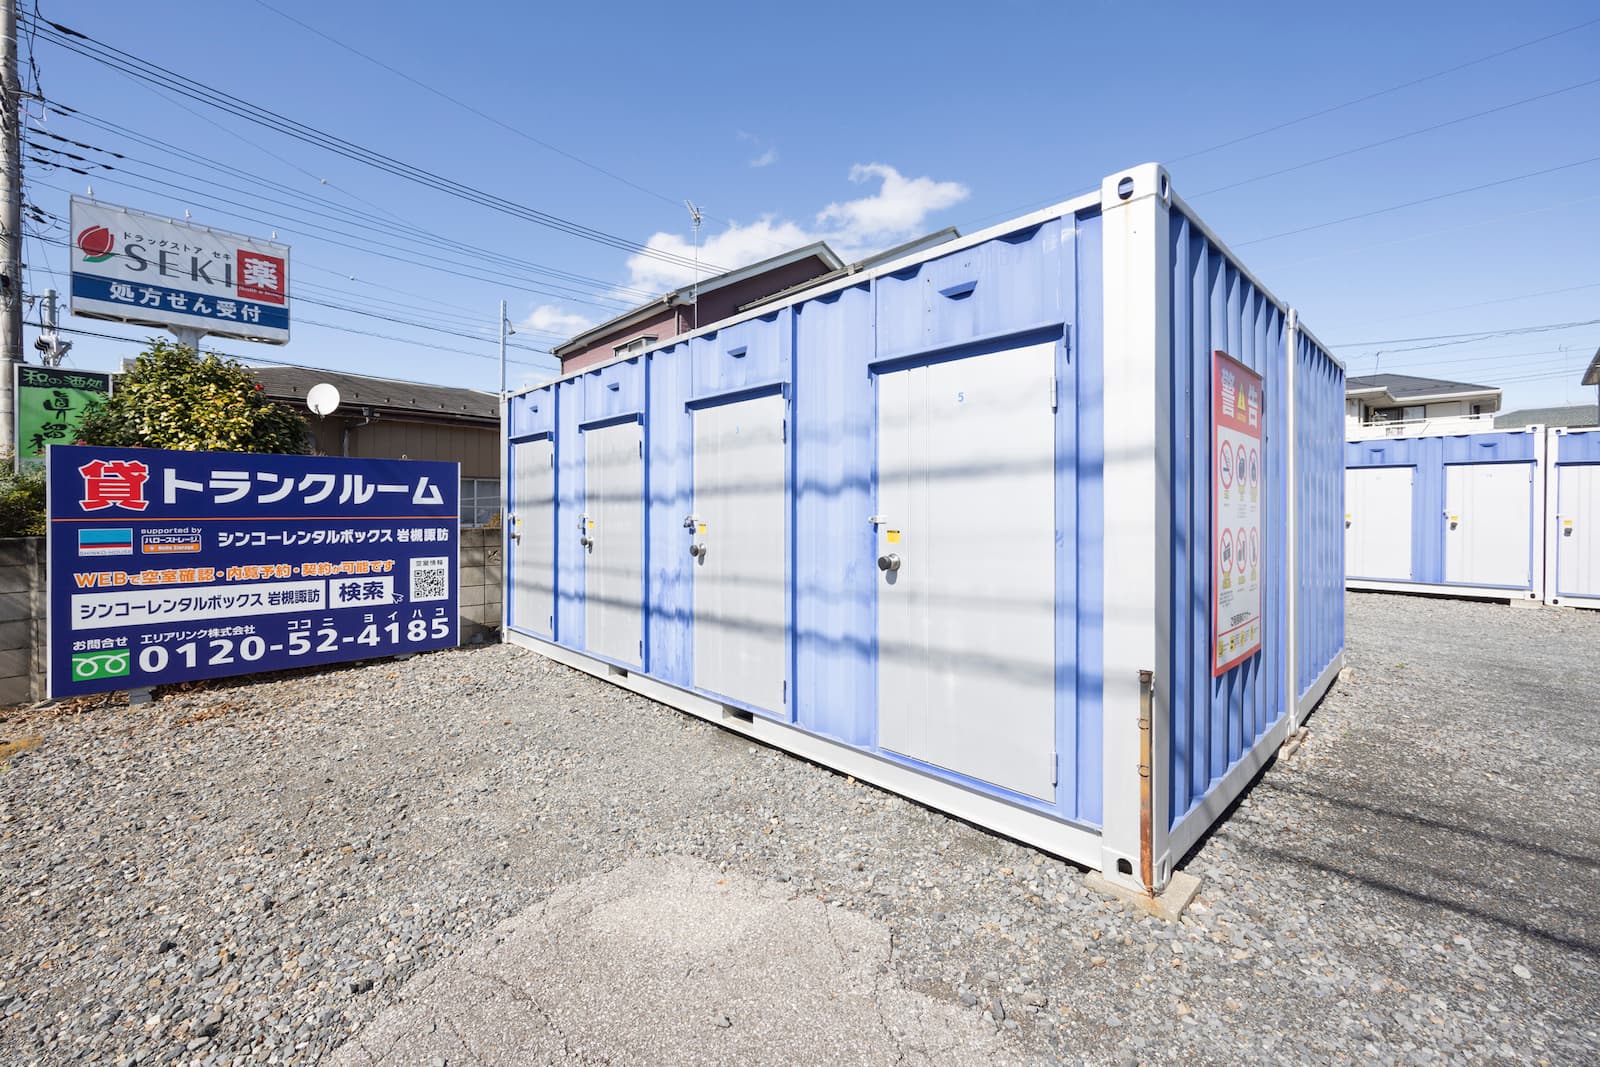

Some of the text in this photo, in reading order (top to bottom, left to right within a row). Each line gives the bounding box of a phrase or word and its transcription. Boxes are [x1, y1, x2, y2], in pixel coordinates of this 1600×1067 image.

[124, 232, 202, 254] ドラッグストア
[124, 243, 232, 288] SEKI
[243, 257, 278, 291] 薬
[109, 281, 262, 323] 処方せん受付
[23, 368, 103, 387] 和の酒処
[957, 391, 965, 402] 5
[78, 459, 444, 512] 貸 トランクルーム
[141, 526, 202, 535] supported by
[144, 535, 199, 544] ハローストレージ
[218, 528, 449, 547] シンコーレンタルボックス 岩槻諏訪
[74, 559, 395, 588] WEBで空室確認・内覧予約・契約が可能です
[338, 581, 384, 603] 検索
[80, 588, 320, 620] シンコーレンタルボックス 岩槻諏訪
[287, 619, 312, 631] ココ
[364, 613, 374, 623] ヨ
[387, 611, 398, 621] イ
[435, 607, 445, 616] コ
[72, 636, 129, 651] お問合せ
[138, 617, 450, 673] 0120-52-4185
[140, 624, 256, 645] エリアリンク株式会社
